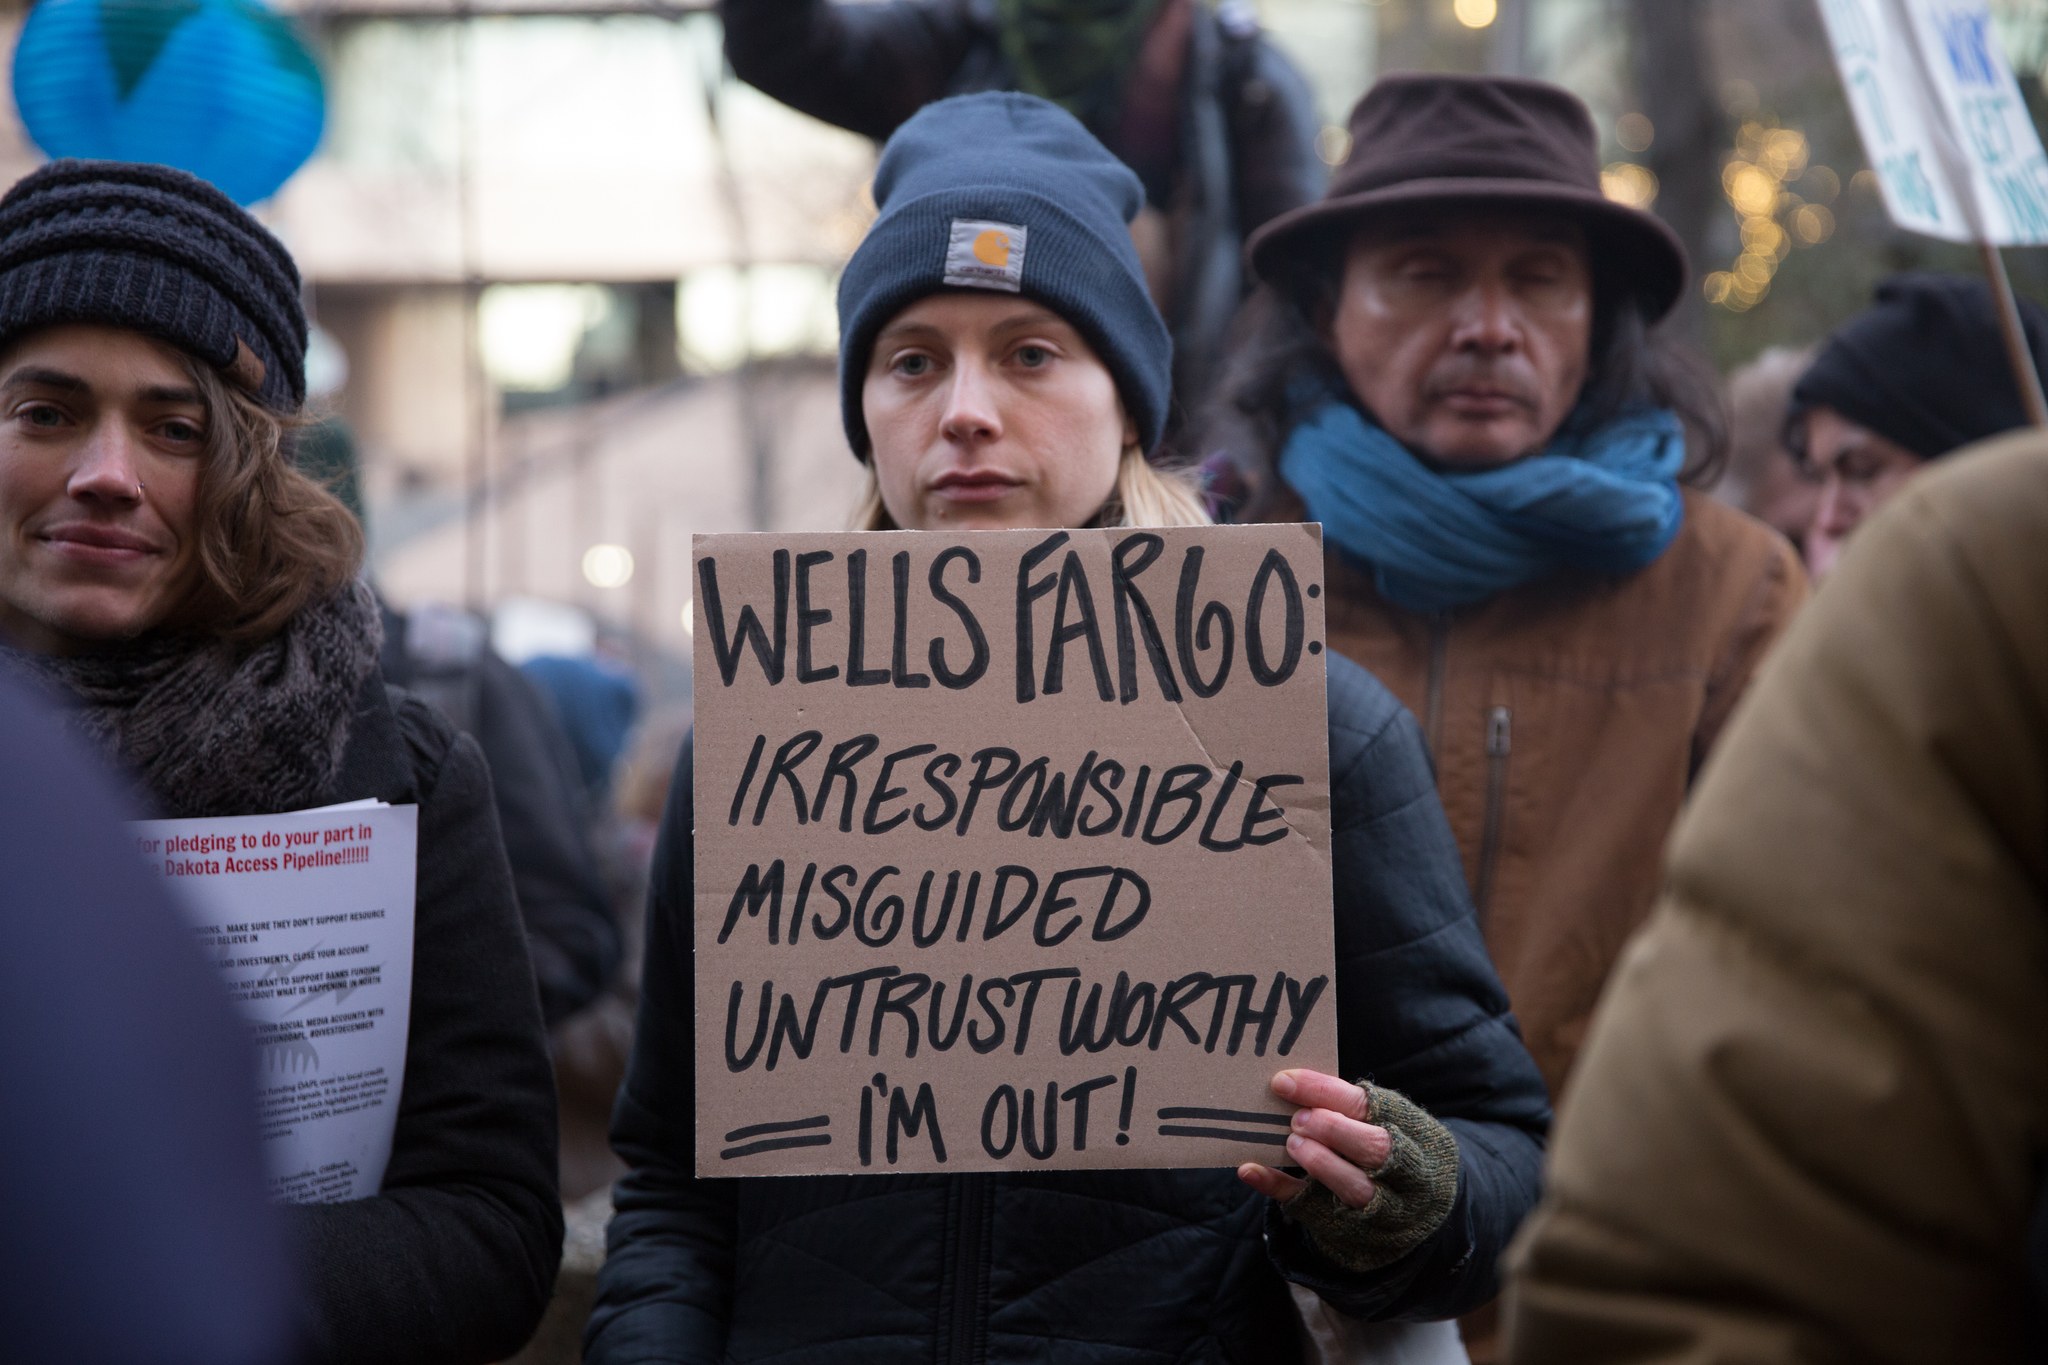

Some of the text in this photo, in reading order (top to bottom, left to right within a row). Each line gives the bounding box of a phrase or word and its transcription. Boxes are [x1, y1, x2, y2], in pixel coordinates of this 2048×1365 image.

[697, 531, 1325, 705] WELLS FARGO:
[727, 730, 1304, 851] IRRESPONSIBLE
[135, 822, 374, 855] for pledging to do your part in
[165, 858, 220, 877] Dakota
[225, 855, 279, 874] Access
[717, 858, 1152, 948] MISGUIDED
[226, 923, 249, 934] MAKE
[251, 921, 271, 932] SURE
[272, 919, 291, 930] THEY
[292, 916, 315, 928] DON'T
[316, 913, 348, 925] SUPPORT
[349, 908, 386, 921] RESOURCE
[217, 934, 248, 945] BELIEVE
[249, 933, 258, 943] IN
[218, 958, 235, 969] AND
[292, 950, 316, 962] CLOSE
[317, 948, 336, 959] YOUR
[338, 943, 370, 957] ACCOUNT
[240, 980, 256, 989] NOT
[257, 977, 278, 988] WANT
[279, 976, 290, 986] TO
[291, 972, 324, 985] SUPPORT
[325, 968, 349, 980] BANKS
[250, 990, 274, 1000] ABOUT
[276, 987, 297, 998] WHAT
[298, 985, 307, 995] IS
[349, 978, 357, 988] IN
[305, 1015, 329, 1027] MEDIA
[724, 966, 1330, 1073] UNTRUSTWORTHY
[858, 1065, 1138, 1167] I'M OUT!
